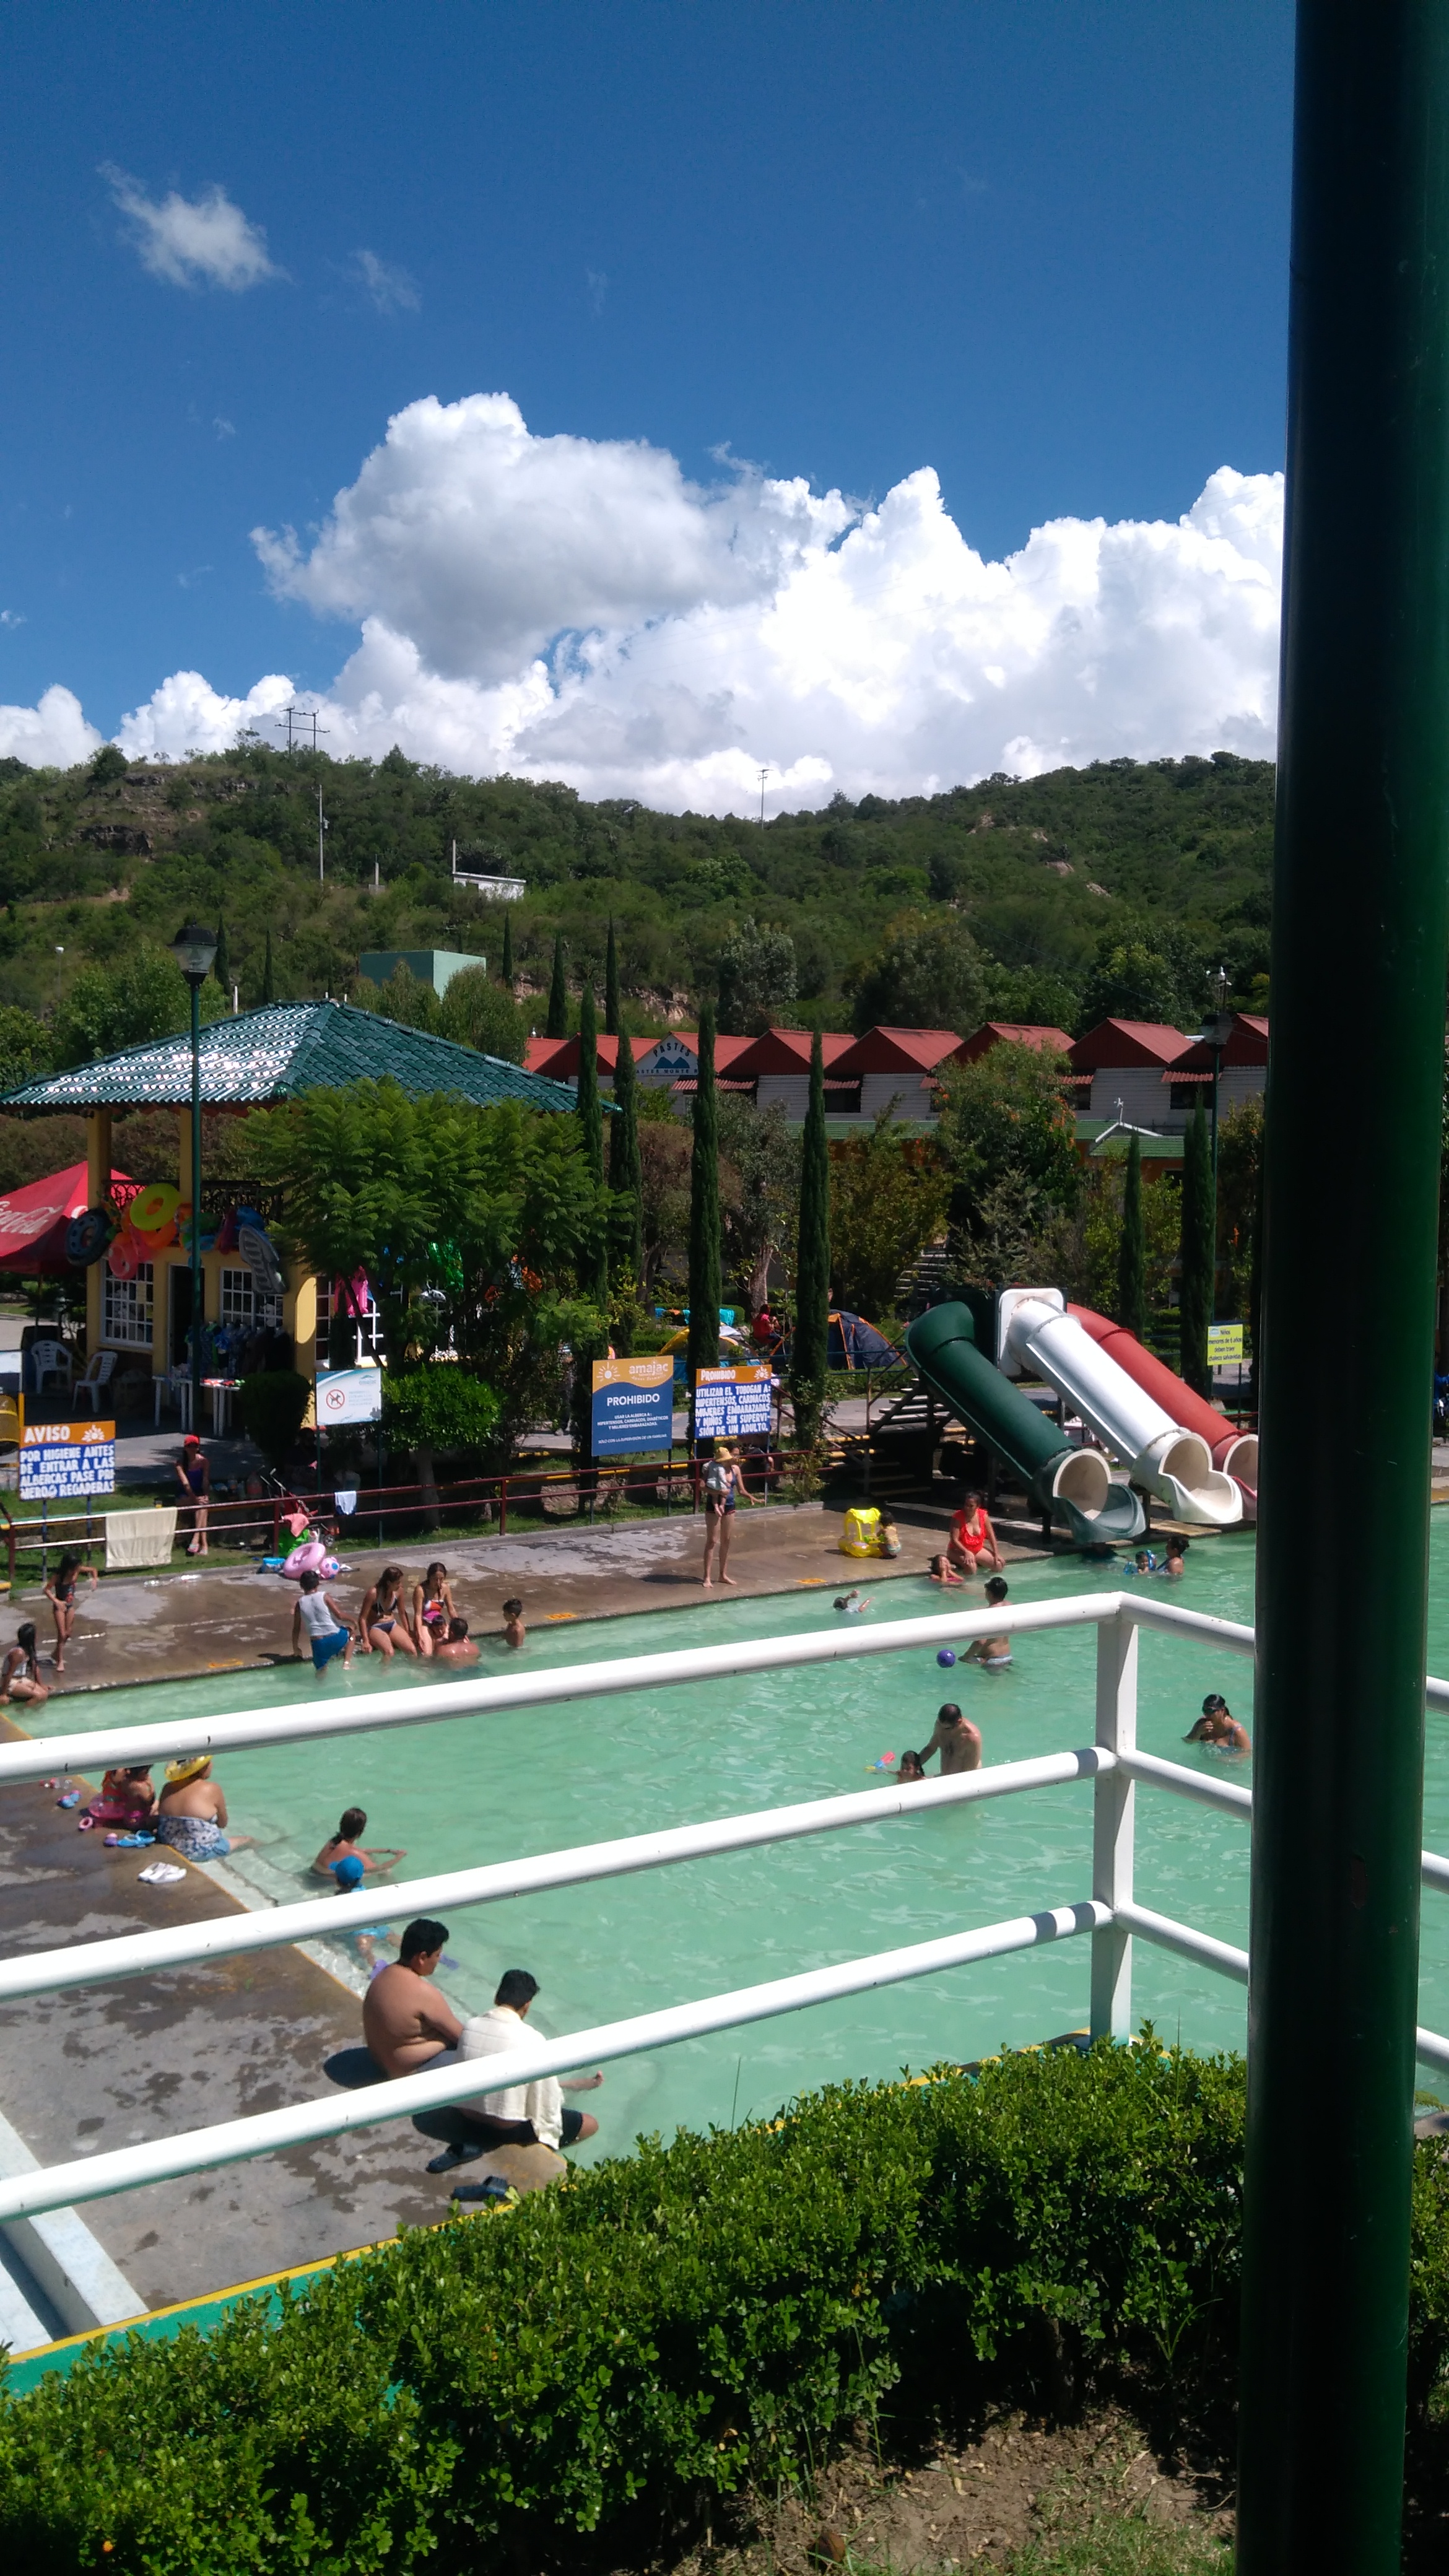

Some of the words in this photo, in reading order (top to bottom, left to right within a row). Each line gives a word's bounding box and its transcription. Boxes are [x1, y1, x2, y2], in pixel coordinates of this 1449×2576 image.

[653, 1042, 691, 1057] PASTES
[629, 1361, 669, 1375] amajac
[701, 1369, 736, 1382] PROHIBIDO
[696, 1387, 723, 1398] UTILIZAR
[724, 1386, 733, 1396] EL
[735, 1384, 762, 1395] TOBOGAN
[607, 1393, 660, 1406] PROHIBIDO
[695, 1406, 724, 1417] MUJERES
[727, 1403, 770, 1414] EMBARAZADAS
[695, 1417, 701, 1427] Y
[703, 1416, 723, 1427] NIÑOS
[726, 1415, 738, 1424] SIN
[24, 1425, 71, 1443] AVISO
[716, 1425, 726, 1435] DE
[728, 1424, 739, 1434] UN
[741, 1422, 768, 1434] ADULTO.
[20, 1450, 41, 1463] POR
[43, 1447, 81, 1461] HIGIENE
[84, 1445, 114, 1458] ANTES
[20, 1463, 33, 1474] DE
[40, 1460, 79, 1473] ENTRAR
[82, 1458, 90, 1470] A
[94, 1456, 115, 1469] LAS
[20, 1472, 67, 1487] ALBERCAS
[71, 1470, 95, 1483] PASE
[59, 1480, 115, 1497] REGADERAS
